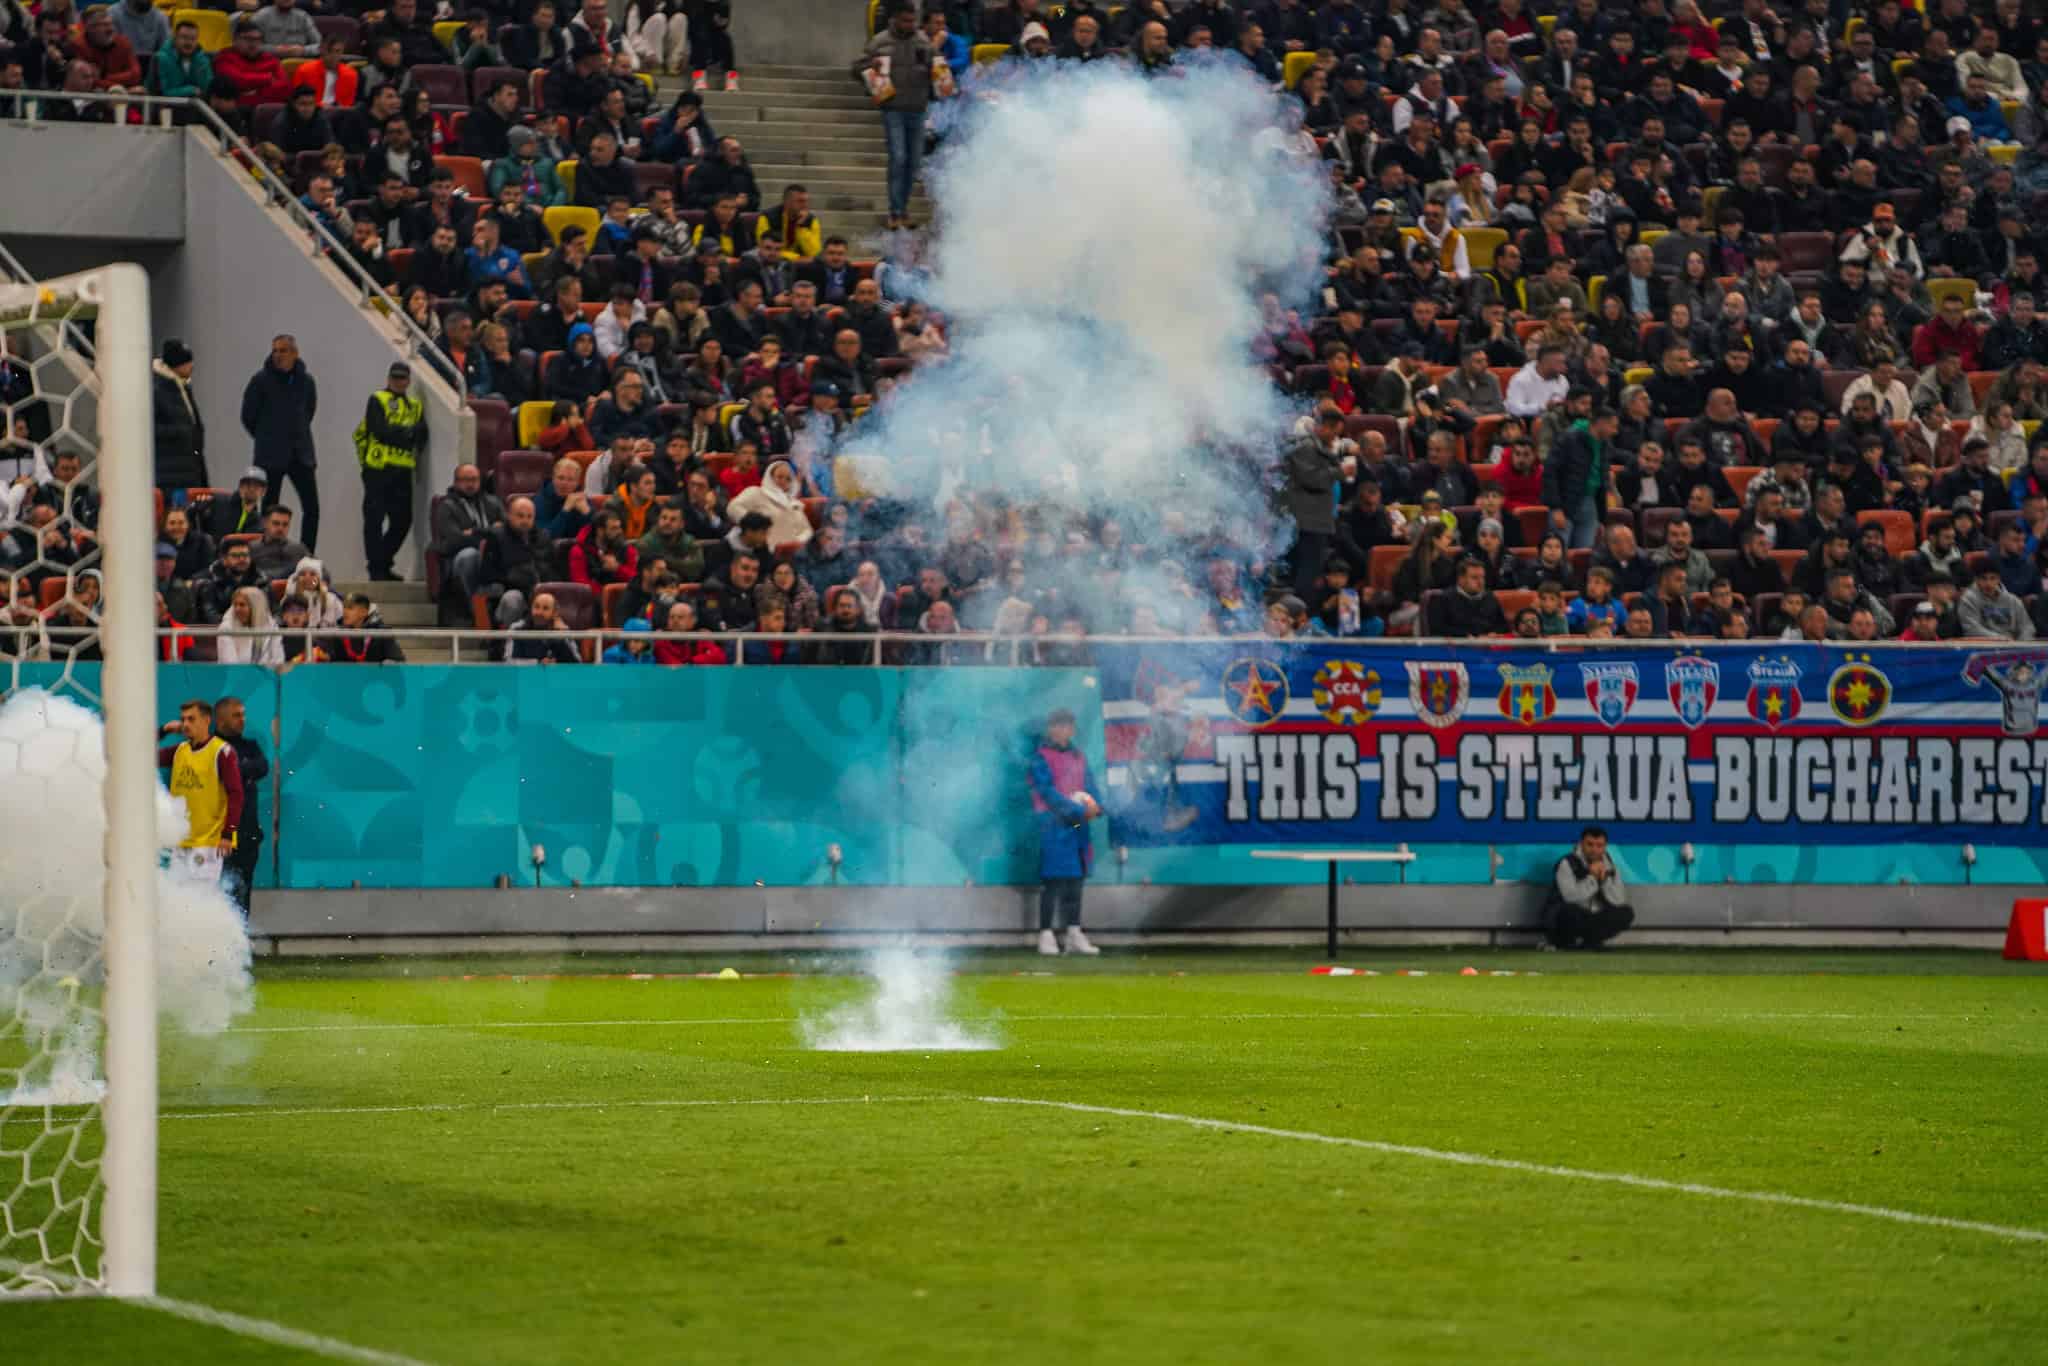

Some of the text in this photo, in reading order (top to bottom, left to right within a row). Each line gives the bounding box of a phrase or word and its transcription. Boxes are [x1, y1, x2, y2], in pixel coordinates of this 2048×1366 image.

[1333, 682, 1361, 696] CCA
[1215, 733, 1358, 820] THIS
[1379, 733, 1437, 820] IS
[1459, 734, 1692, 821] STEAUA
